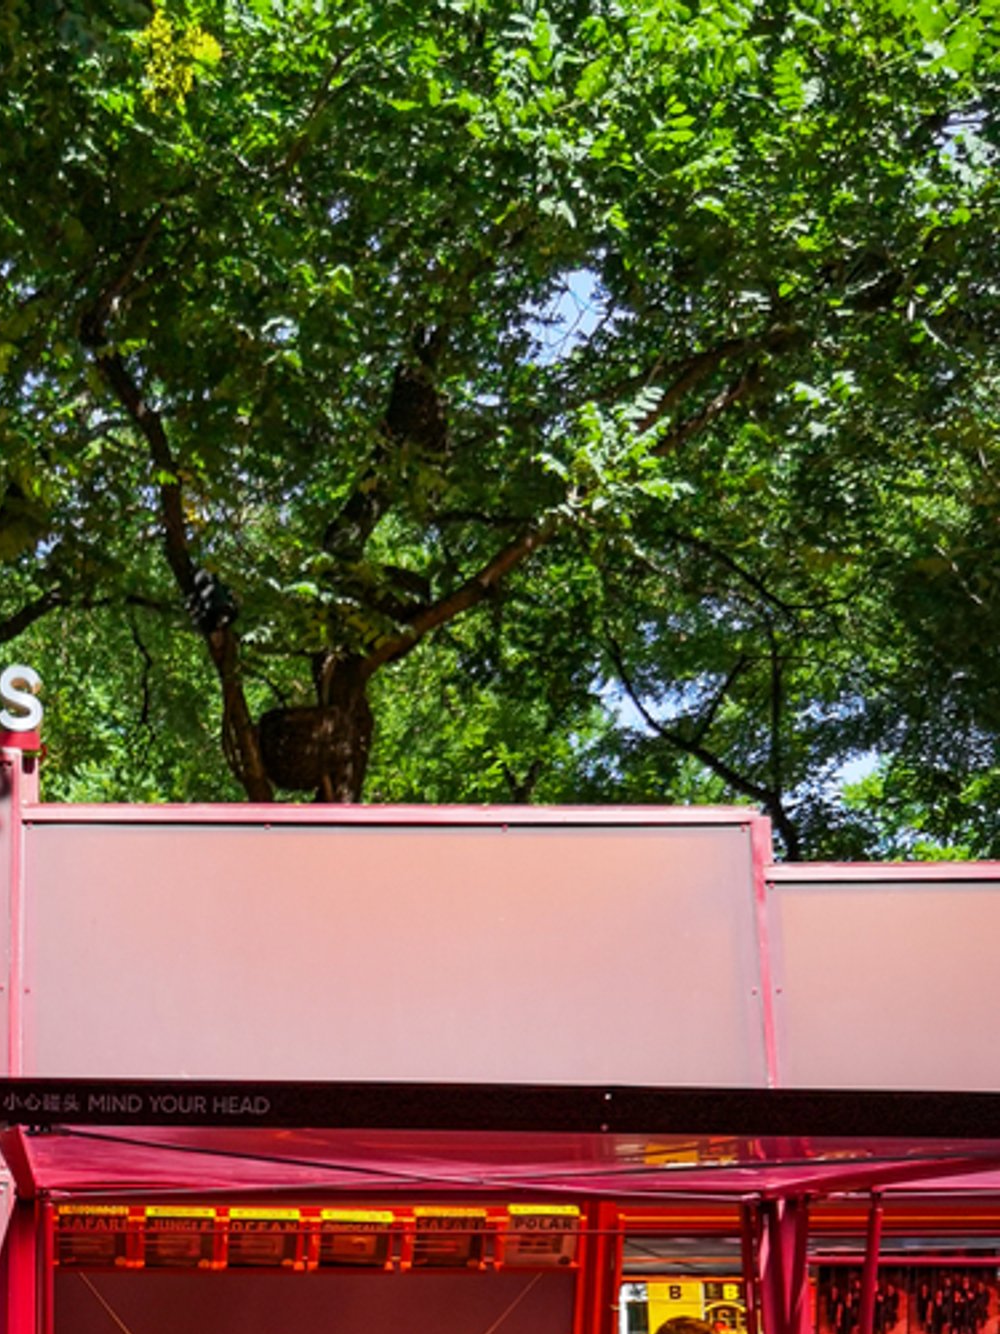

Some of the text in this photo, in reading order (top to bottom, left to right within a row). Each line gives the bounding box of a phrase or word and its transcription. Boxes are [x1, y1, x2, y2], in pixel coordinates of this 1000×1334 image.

[3, 1093, 271, 1115] 小心碰头 MIND YOUR HEAD
[151, 1218, 212, 1231] JUNGLE
[231, 1221, 298, 1232] OCEAN
[514, 1217, 573, 1230] POLAR
[668, 1285, 682, 1300] B
[722, 1283, 740, 1300] B
